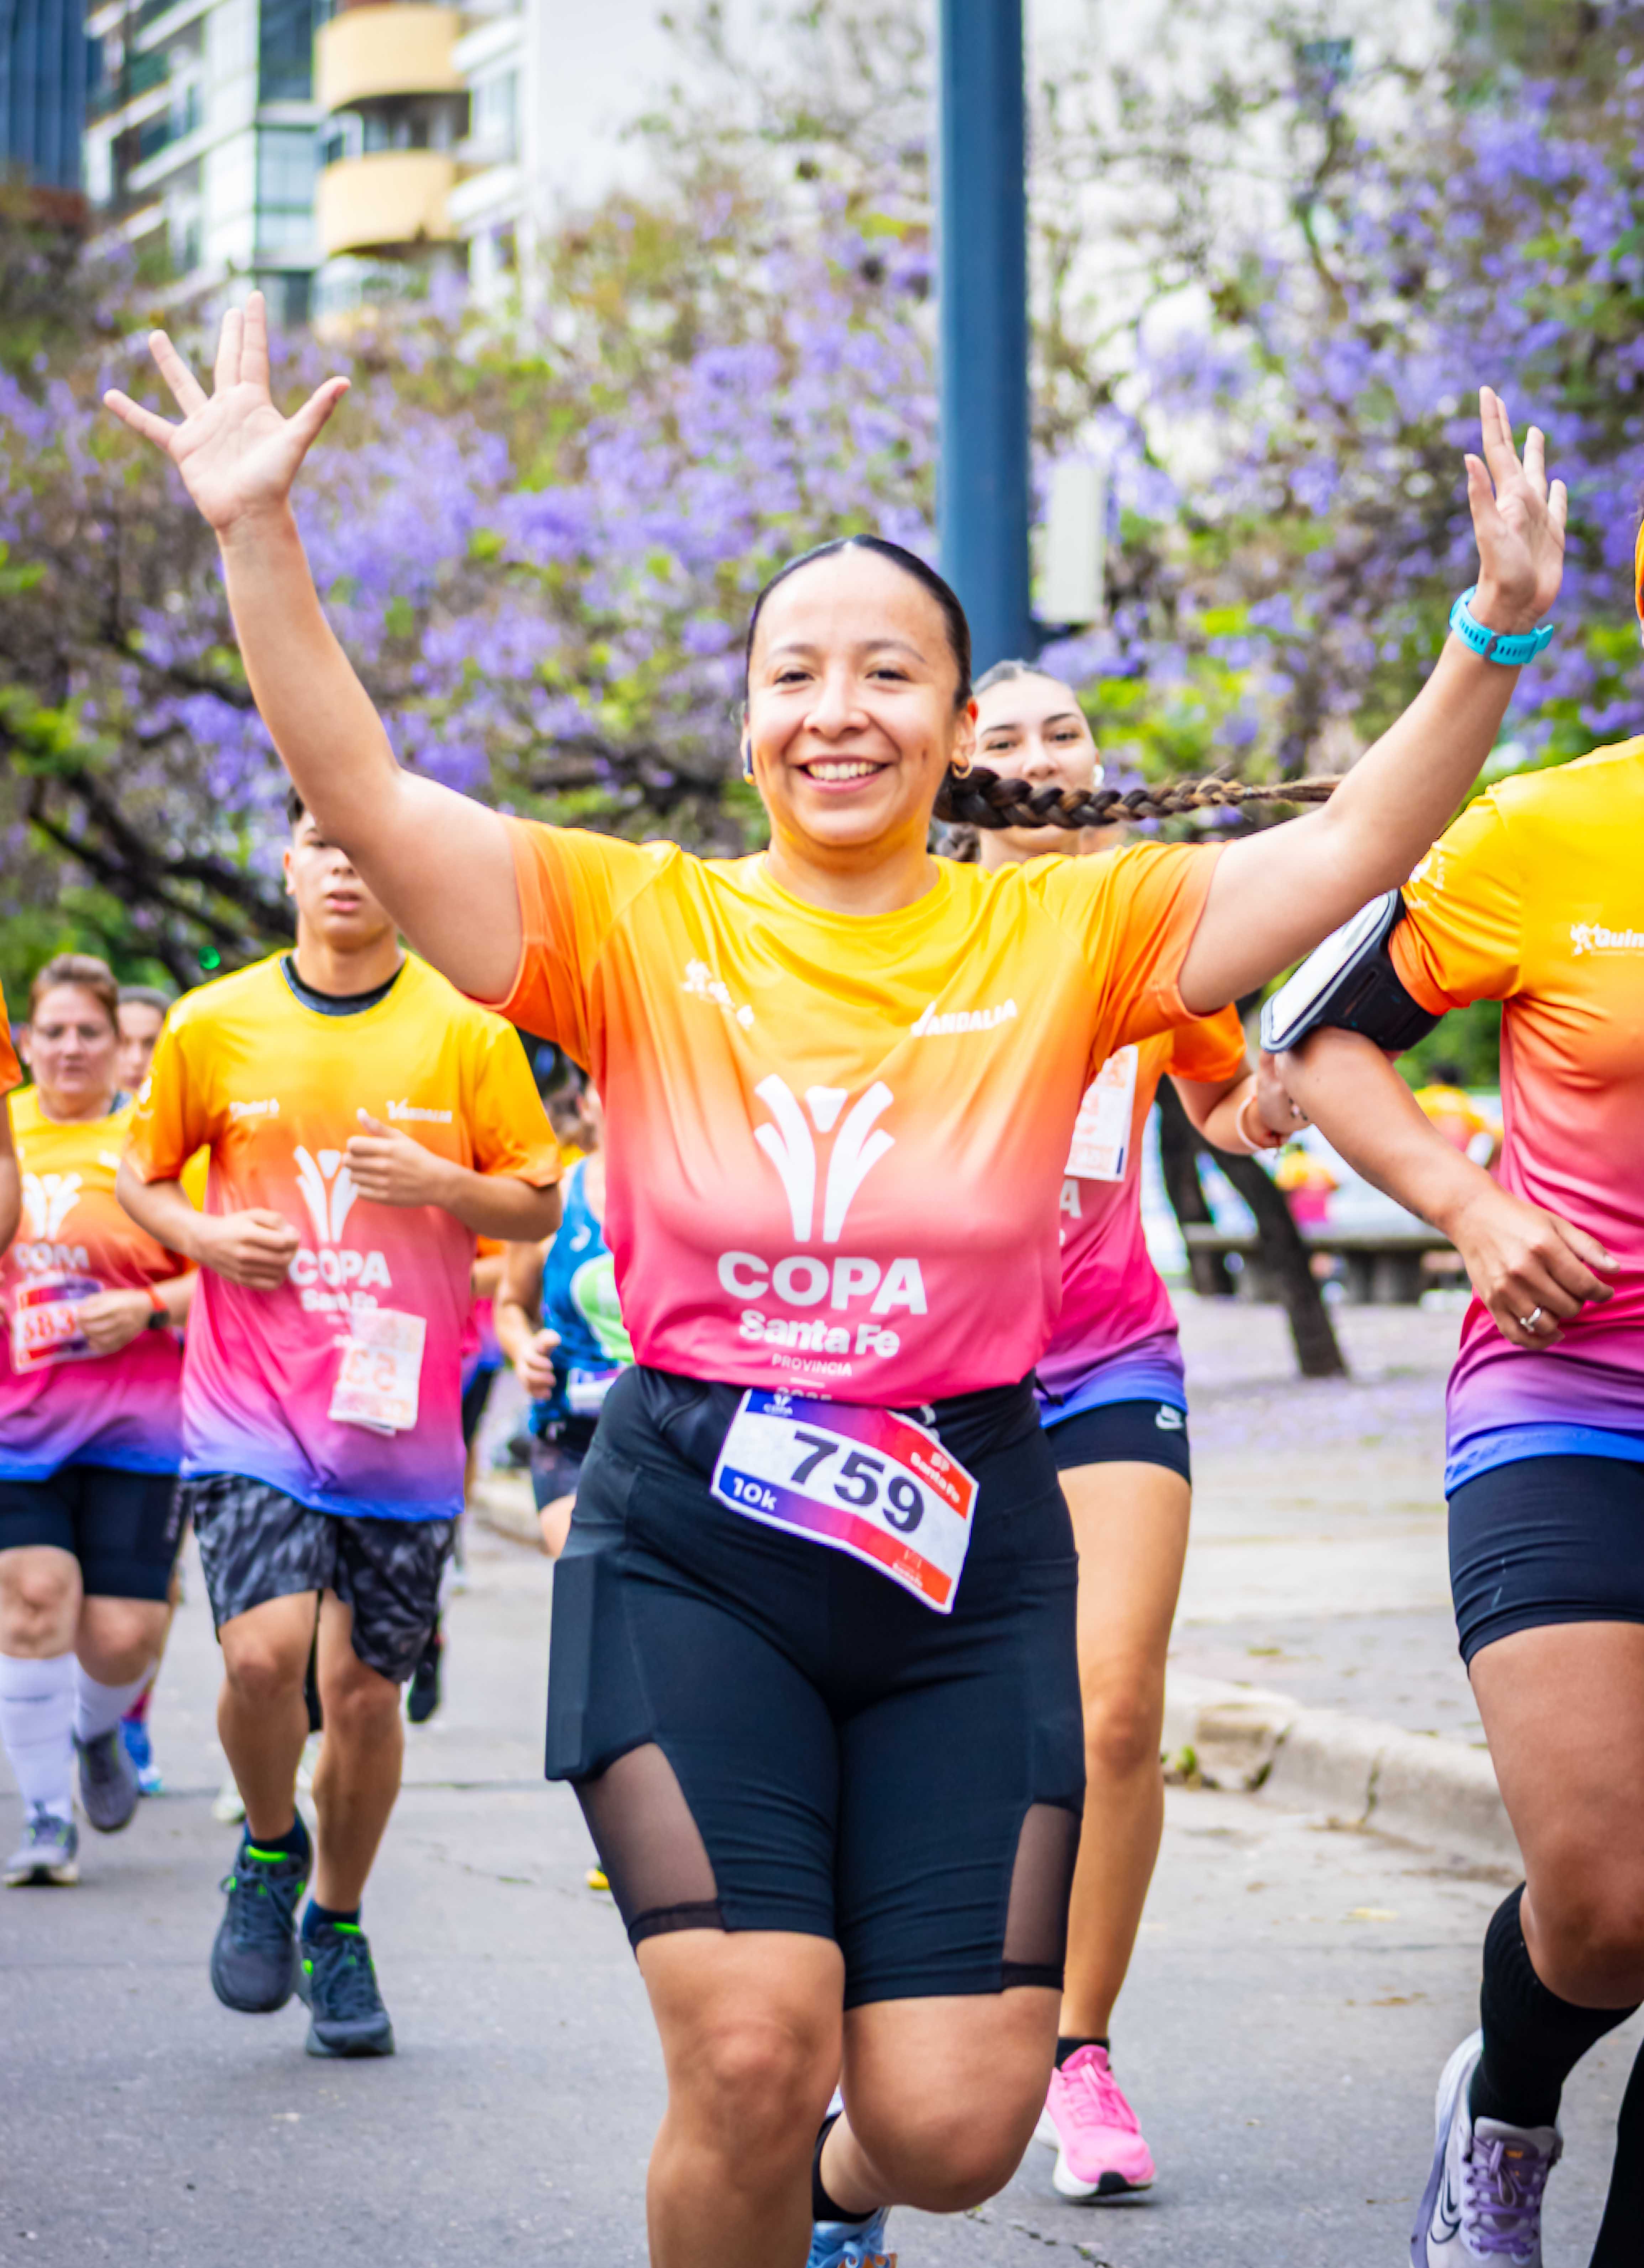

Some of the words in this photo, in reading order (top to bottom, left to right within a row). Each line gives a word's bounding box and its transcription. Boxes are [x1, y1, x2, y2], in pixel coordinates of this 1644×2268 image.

[289, 1249, 392, 1288] COPA
[717, 1251, 928, 1315] COPA
[739, 1309, 851, 1354] Santa
[855, 1323, 900, 1358] Fe
[772, 1353, 852, 1377] PROVINCIA
[733, 1477, 778, 1511] 10k
[790, 1430, 925, 1534] 759
